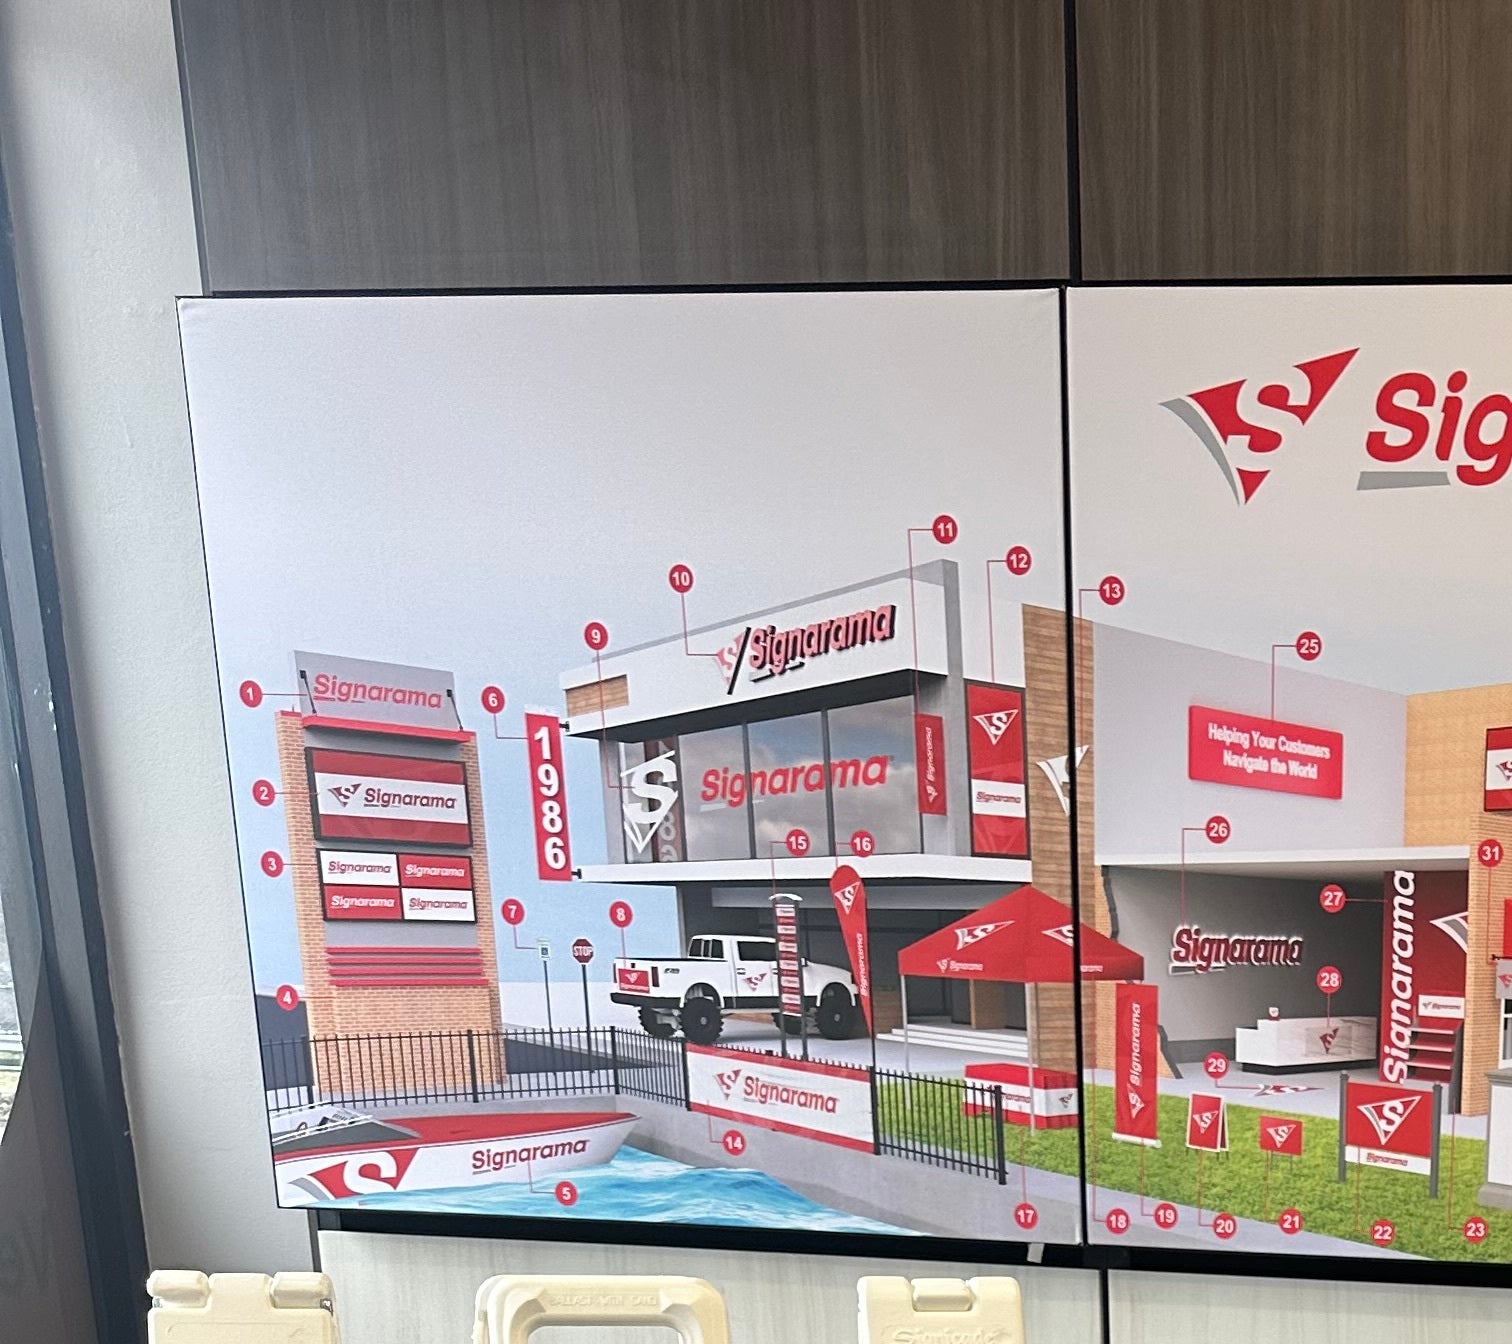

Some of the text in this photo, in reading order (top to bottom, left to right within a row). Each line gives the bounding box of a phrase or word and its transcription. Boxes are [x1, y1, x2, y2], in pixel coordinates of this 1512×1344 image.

[749, 604, 896, 673] Signarama
[313, 673, 442, 710] Signarama
[1208, 723, 1330, 759] Helping Your Customers
[701, 755, 888, 809] Signarama
[1223, 750, 1317, 779] Navigate the World
[364, 787, 457, 809] Signarama
[573, 946, 593, 957] STOP
[742, 1074, 839, 1114] Signarama
[471, 1139, 589, 1172] Signarama
